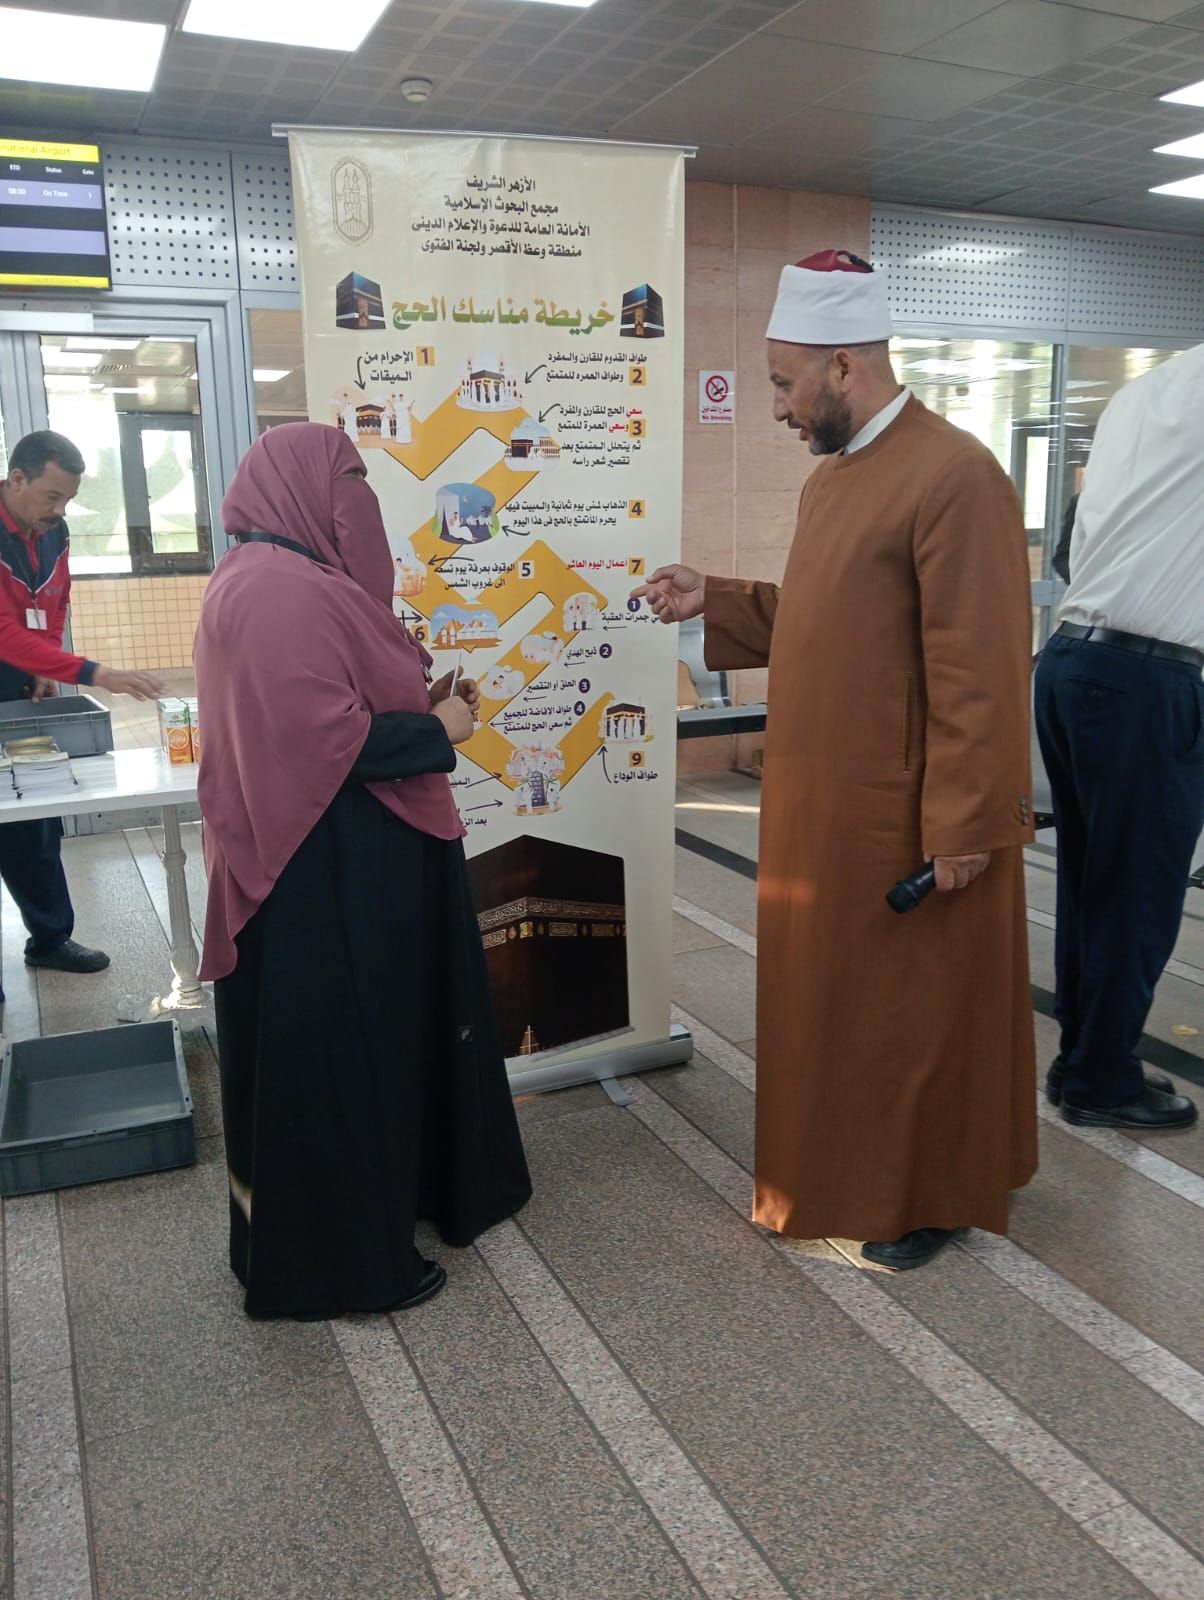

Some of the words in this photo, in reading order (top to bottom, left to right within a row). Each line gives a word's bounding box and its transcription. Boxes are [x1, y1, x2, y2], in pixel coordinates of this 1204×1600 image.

[466, 174, 505, 191] الشريف
[507, 176, 536, 193] الأزهر
[444, 194, 492, 212] الإسلامية
[494, 195, 529, 216] البحوث
[530, 203, 559, 217] مجمع
[447, 218, 487, 234] والإعلام
[489, 219, 522, 234] للدعوة
[524, 221, 554, 235] العامة
[556, 221, 590, 236] الأمانة
[421, 238, 454, 253] الفتوى
[456, 239, 486, 256] ولجنة
[489, 239, 522, 256] الأقصر
[523, 242, 546, 259] وعظ
[548, 243, 582, 257] منطقة
[391, 295, 446, 331] الحج
[452, 296, 529, 324] مناسك
[534, 297, 615, 335] خريطة
[363, 351, 379, 364] من
[381, 350, 414, 364] الإحرام
[420, 347, 429, 364] 1
[579, 352, 603, 363] للقارن
[604, 352, 628, 364] القدوم
[628, 353, 647, 364] طواف
[546, 370, 575, 382] للمتمتع
[601, 371, 624, 382] وطواف
[632, 368, 643, 384] 2
[560, 405, 582, 416] والمفرد
[583, 405, 606, 416] للقارن
[607, 406, 625, 417] الحج
[584, 420, 608, 431] العمرة
[632, 420, 643, 436] 3
[561, 442, 574, 453] بعد
[607, 441, 631, 452] يتحلل
[632, 440, 641, 452] ثم
[592, 456, 606, 467] شعر
[607, 456, 630, 467] تقصير
[573, 503, 584, 512] يوم
[602, 500, 628, 512] الذهاب
[631, 502, 642, 516] 4
[513, 517, 530, 527] اليوم
[531, 516, 543, 525] هذا
[553, 516, 572, 527] بالحج
[599, 517, 617, 526] يحرم
[455, 566, 467, 575] يوم
[468, 563, 491, 575] بعرفة
[491, 562, 515, 574] الوقوف
[521, 562, 531, 577] 5
[588, 559, 605, 570] اليوم
[631, 559, 641, 574] 7
[444, 578, 470, 590] الشمس
[471, 578, 493, 589] غروب
[602, 612, 624, 623] العقبة
[625, 612, 649, 623] جمرات
[415, 626, 425, 641] 6
[503, 709, 527, 721] للجميع
[555, 705, 572, 716] طواف
[531, 721, 548, 732] الحج
[564, 717, 573, 729] ثم
[632, 752, 642, 766] 9
[613, 770, 636, 784] الوداع
[637, 770, 658, 781] طواف
[475, 818, 488, 827] بعد
